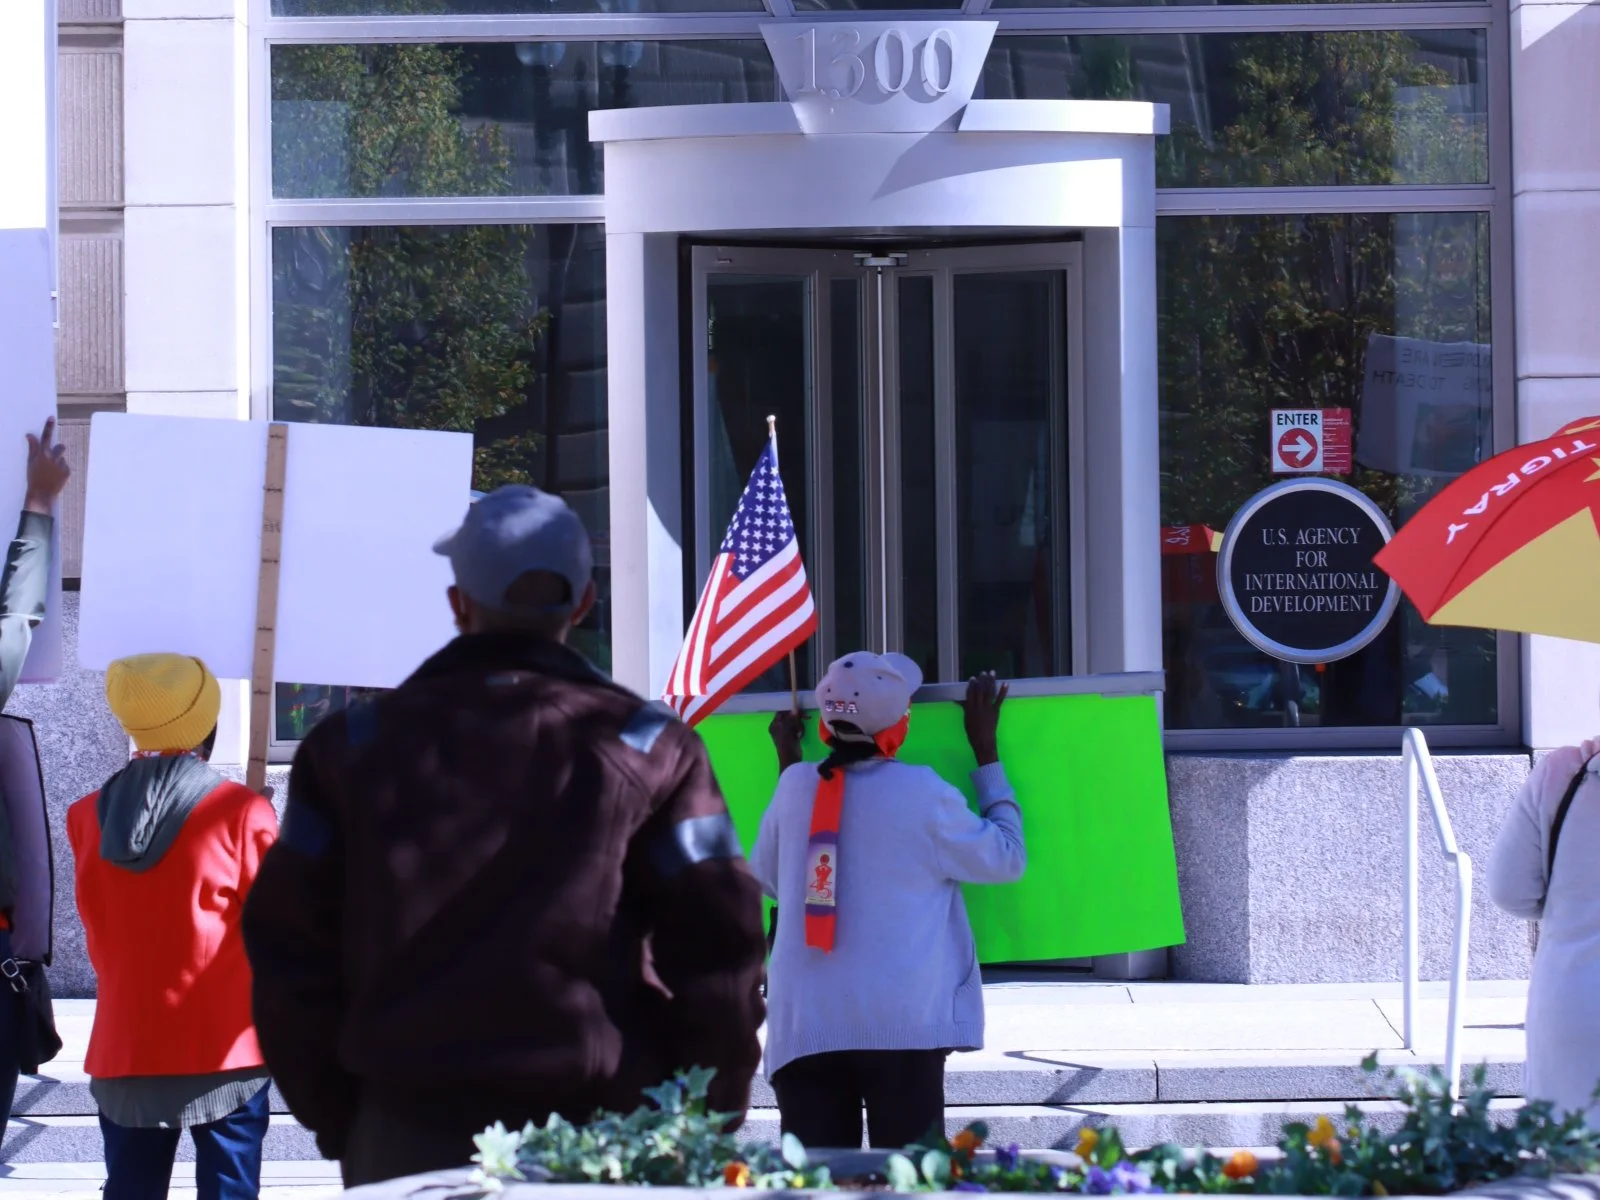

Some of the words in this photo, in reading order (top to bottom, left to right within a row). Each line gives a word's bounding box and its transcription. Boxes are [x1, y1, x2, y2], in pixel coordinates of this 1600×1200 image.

[795, 27, 956, 98] 1300
[1277, 413, 1319, 426] ENTER
[1446, 439, 1597, 545] TIGRAY
[1262, 528, 1290, 545] U.S.
[1295, 527, 1360, 545] AGENCY
[1295, 550, 1328, 568] FOR
[1245, 572, 1379, 590] INTERNATIONAL
[1251, 594, 1373, 613] DEVELOPMENT
[825, 699, 858, 714] USA
